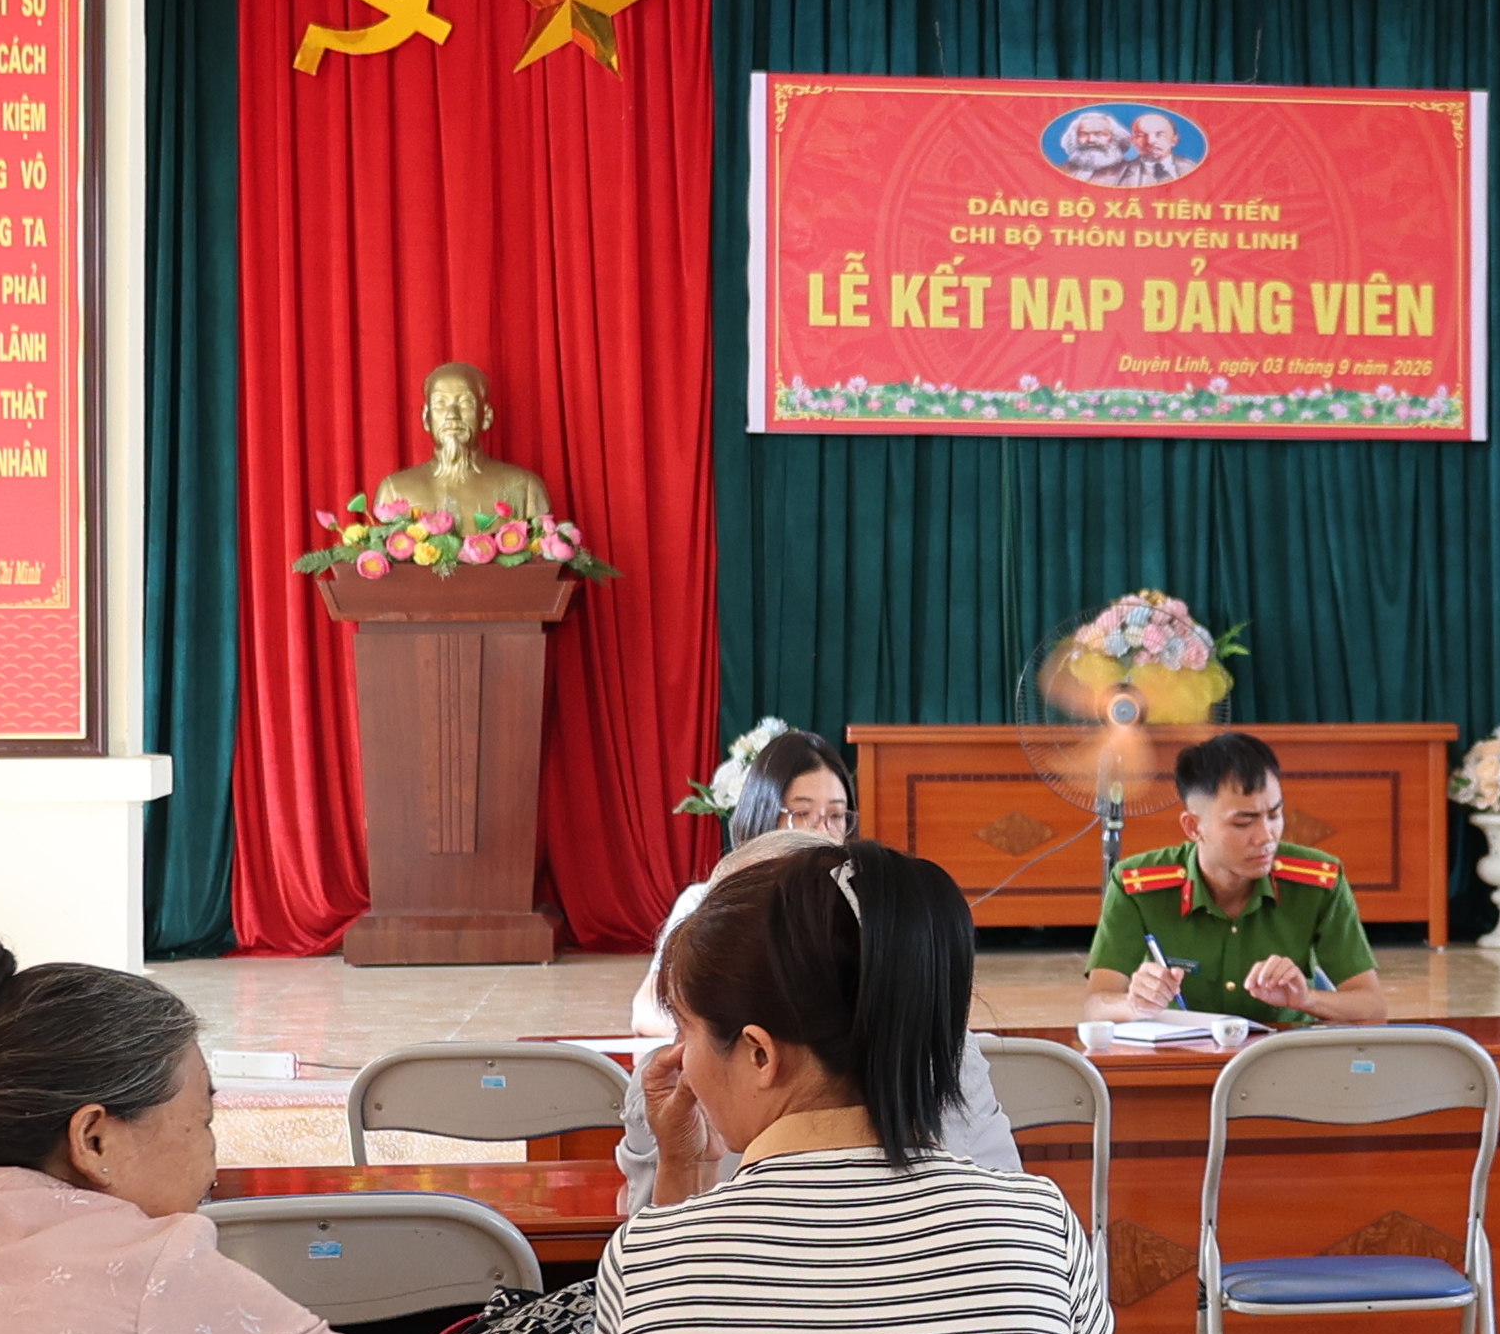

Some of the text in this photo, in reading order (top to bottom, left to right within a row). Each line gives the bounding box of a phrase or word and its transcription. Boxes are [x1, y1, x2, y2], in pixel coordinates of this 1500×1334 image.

[967, 190, 1280, 223] ĐẢNG BỘ XÃ TIÊN TIẾN
[949, 222, 1297, 251] CHI BỘ THÔN DUYÊN LINH
[1, 262, 46, 305] PHẢI
[807, 250, 1434, 343] LỄ KẾT NẠP ĐẢNG VIÊN
[0, 381, 48, 429] THẬT
